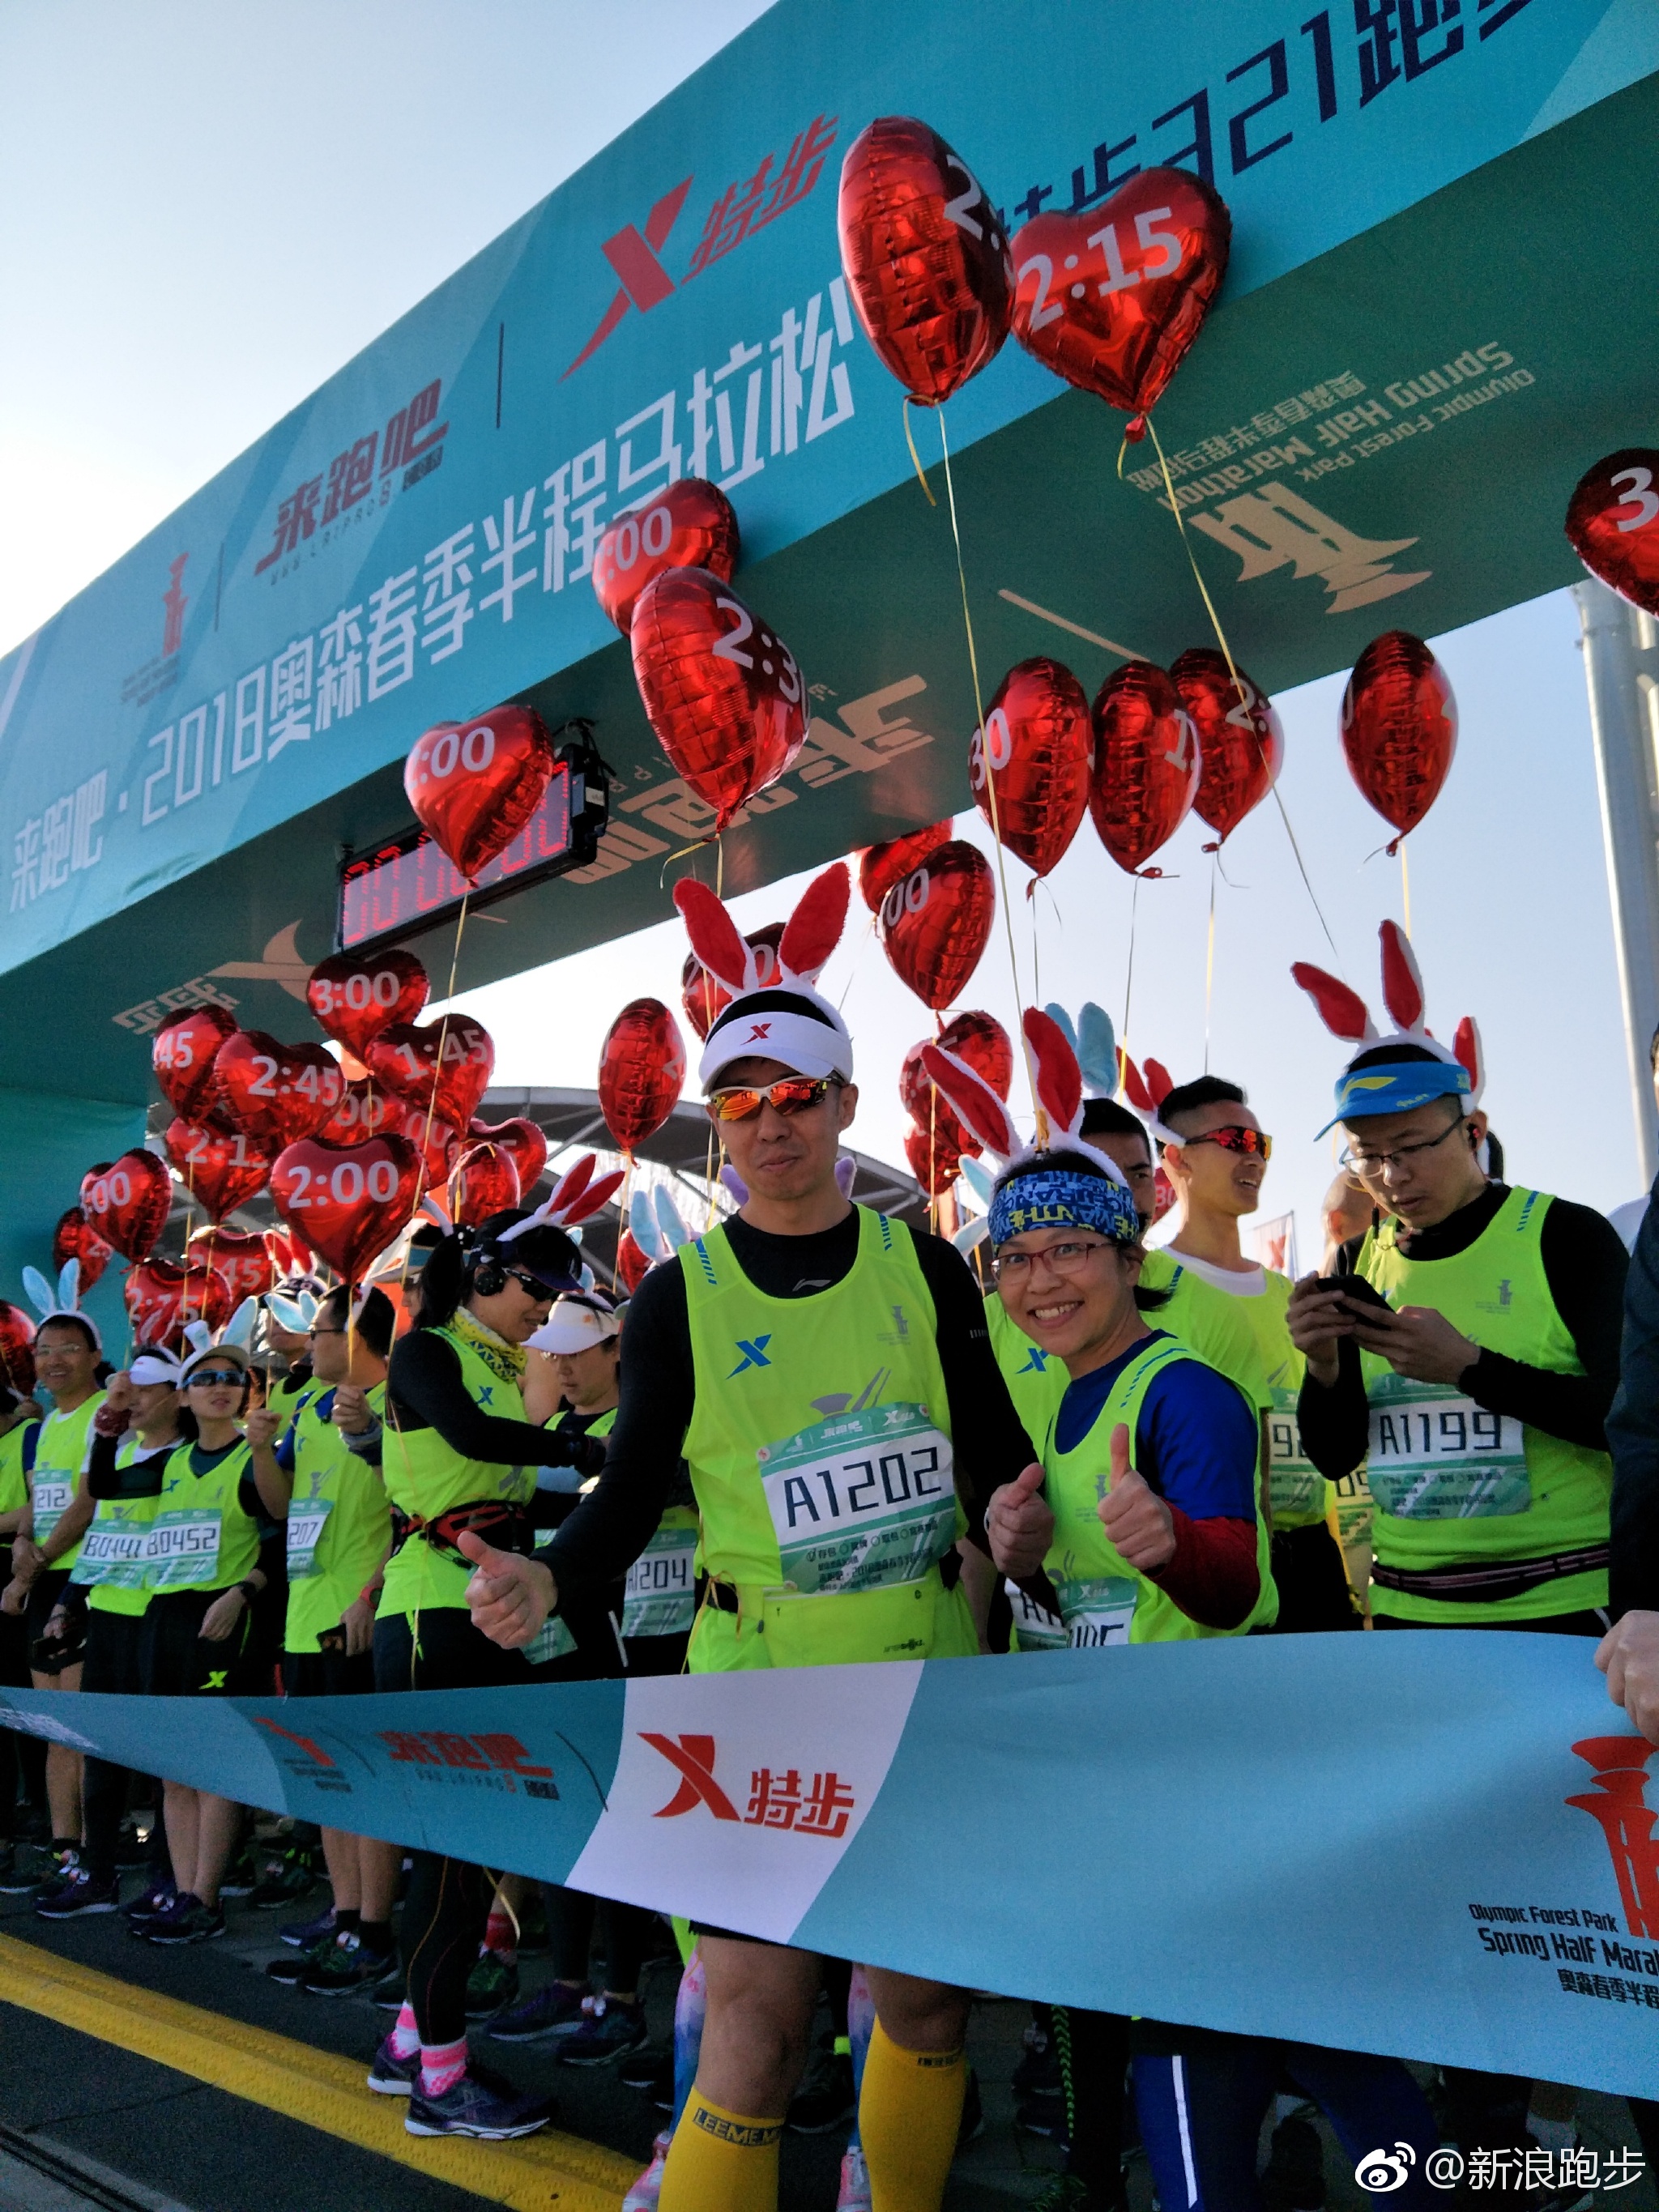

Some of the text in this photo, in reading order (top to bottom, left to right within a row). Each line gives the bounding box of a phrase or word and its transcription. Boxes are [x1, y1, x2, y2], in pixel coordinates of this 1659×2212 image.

[1017, 207, 1183, 333] 2:15
[1156, 341, 1514, 512] Spring Half Marathon
[1295, 369, 1536, 483] Olympic Forest Park
[254, 377, 450, 576] 来跑吧
[314, 971, 401, 1016] 3:00
[394, 1028, 486, 1081] 1:45
[248, 1055, 339, 1106] 2:45
[185, 1127, 270, 1169] 2:1
[288, 1160, 399, 1208] 2:00
[1380, 1411, 1502, 1455] A1199
[783, 1446, 942, 1528] A1202
[147, 1528, 217, 1557] B0452
[743, 1768, 855, 1839] 特步
[1468, 1903, 1619, 1933] Olympic Forest Park
[1477, 1927, 1550, 1962] Spring
[1549, 1932, 1597, 1964] Half
